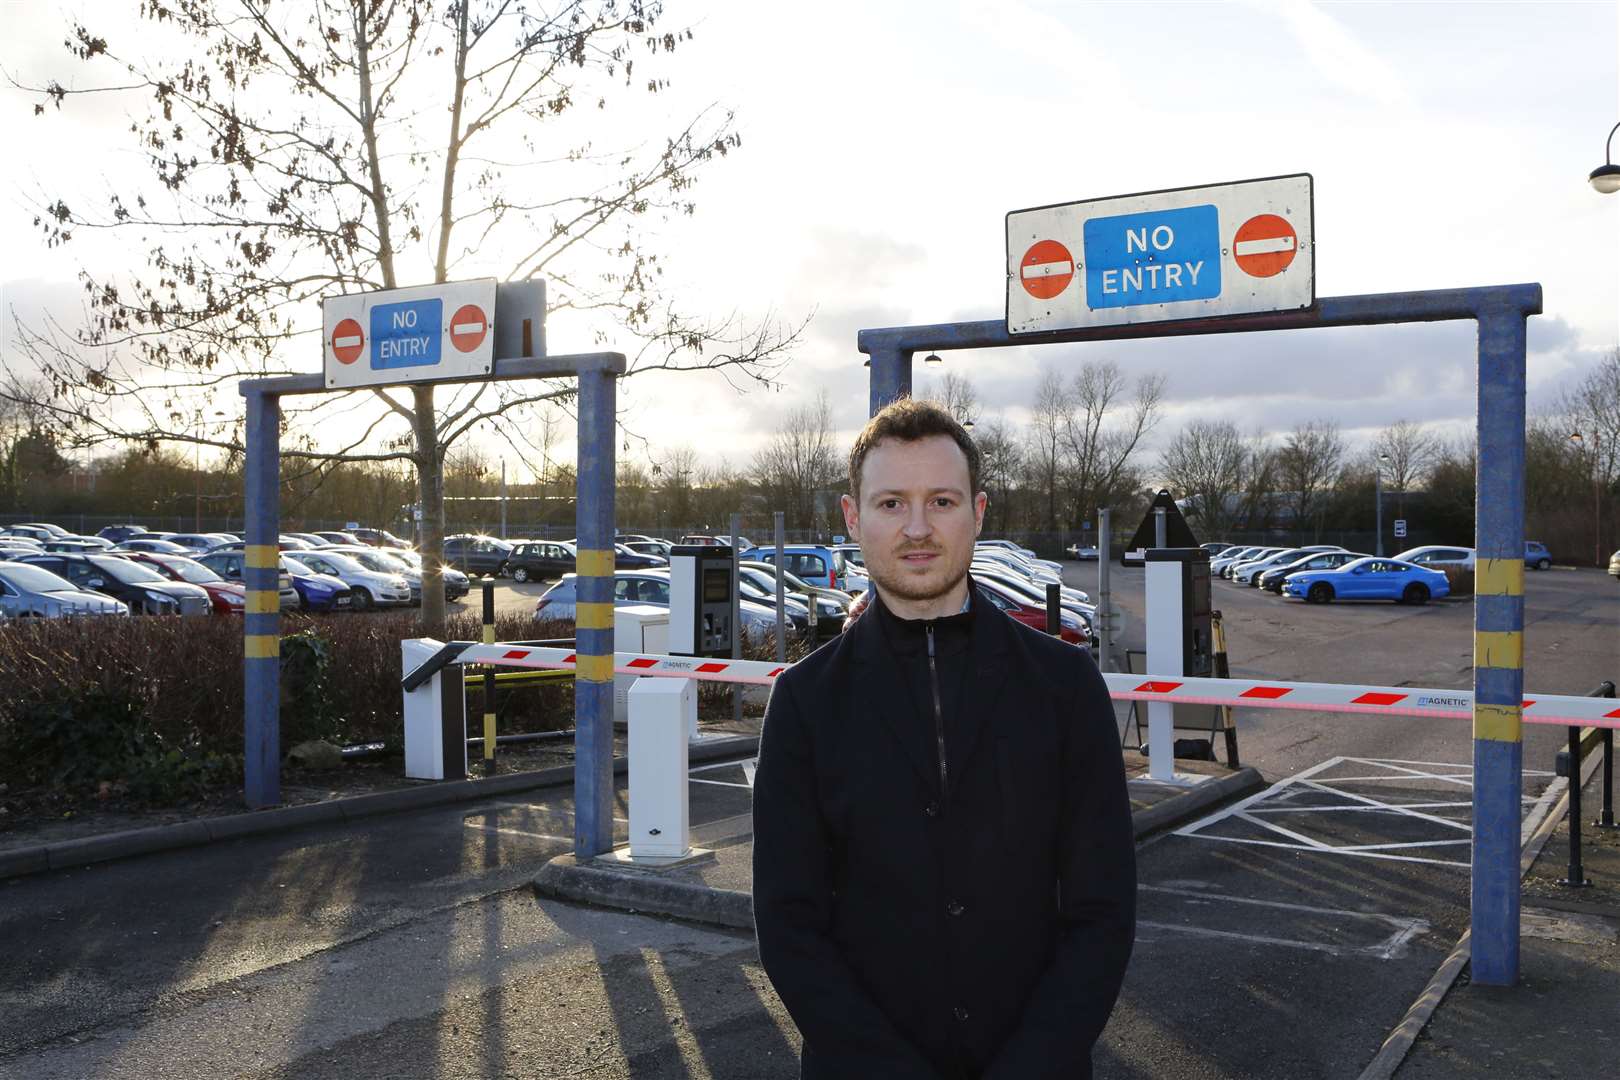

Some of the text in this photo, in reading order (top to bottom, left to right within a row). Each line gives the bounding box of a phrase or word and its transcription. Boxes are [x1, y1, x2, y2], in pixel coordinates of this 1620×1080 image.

[1126, 225, 1174, 253] NO
[1103, 260, 1204, 294] ENTRY
[393, 310, 417, 329] NO
[380, 337, 430, 359] ENTRY
